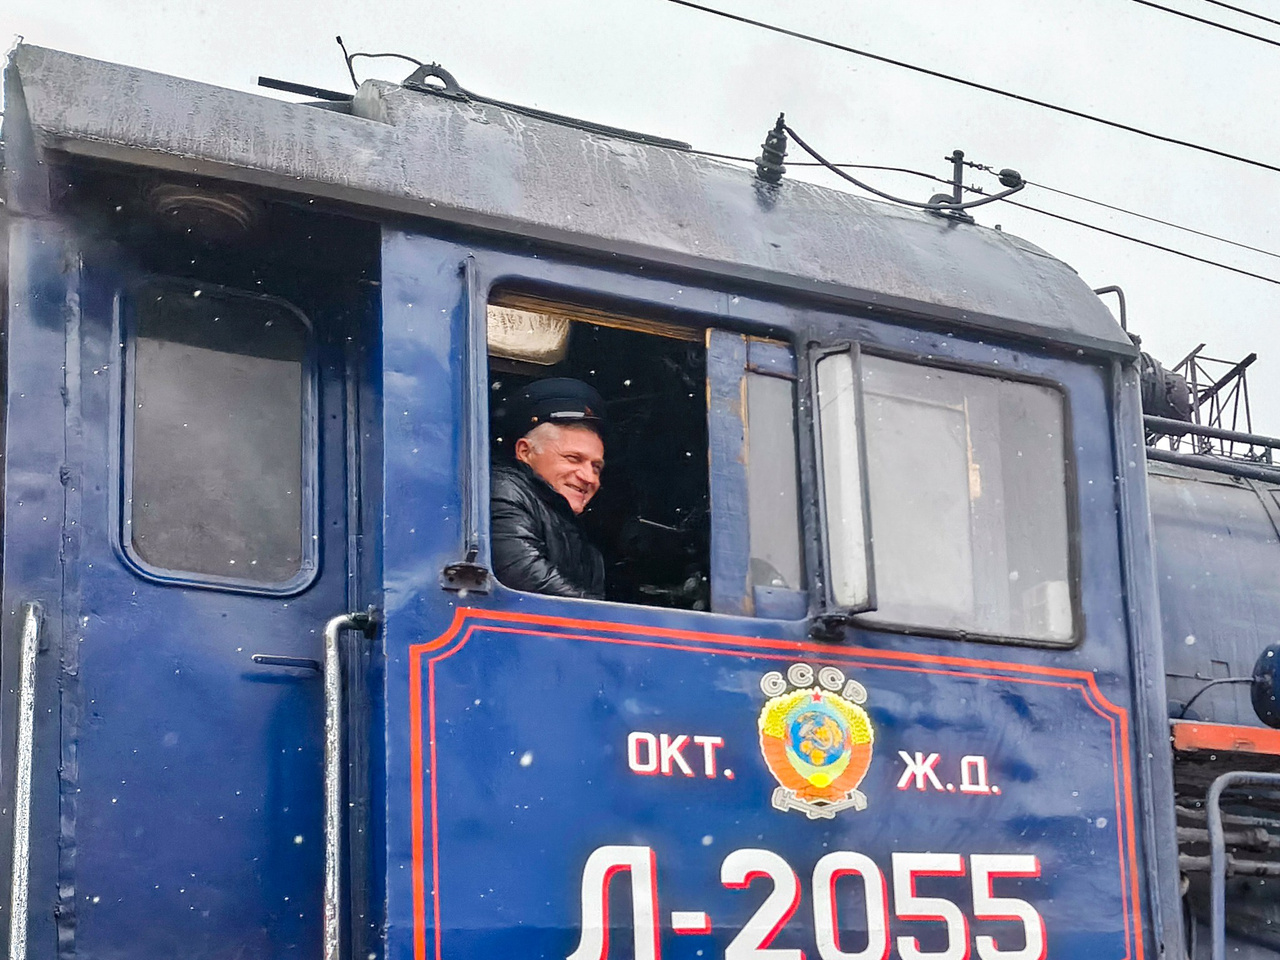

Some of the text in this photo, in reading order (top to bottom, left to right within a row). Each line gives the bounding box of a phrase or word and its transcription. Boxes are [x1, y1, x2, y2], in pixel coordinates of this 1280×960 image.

[760, 663, 867, 704] СССР
[627, 731, 1001, 796] ОКТ. Ж.Д.
